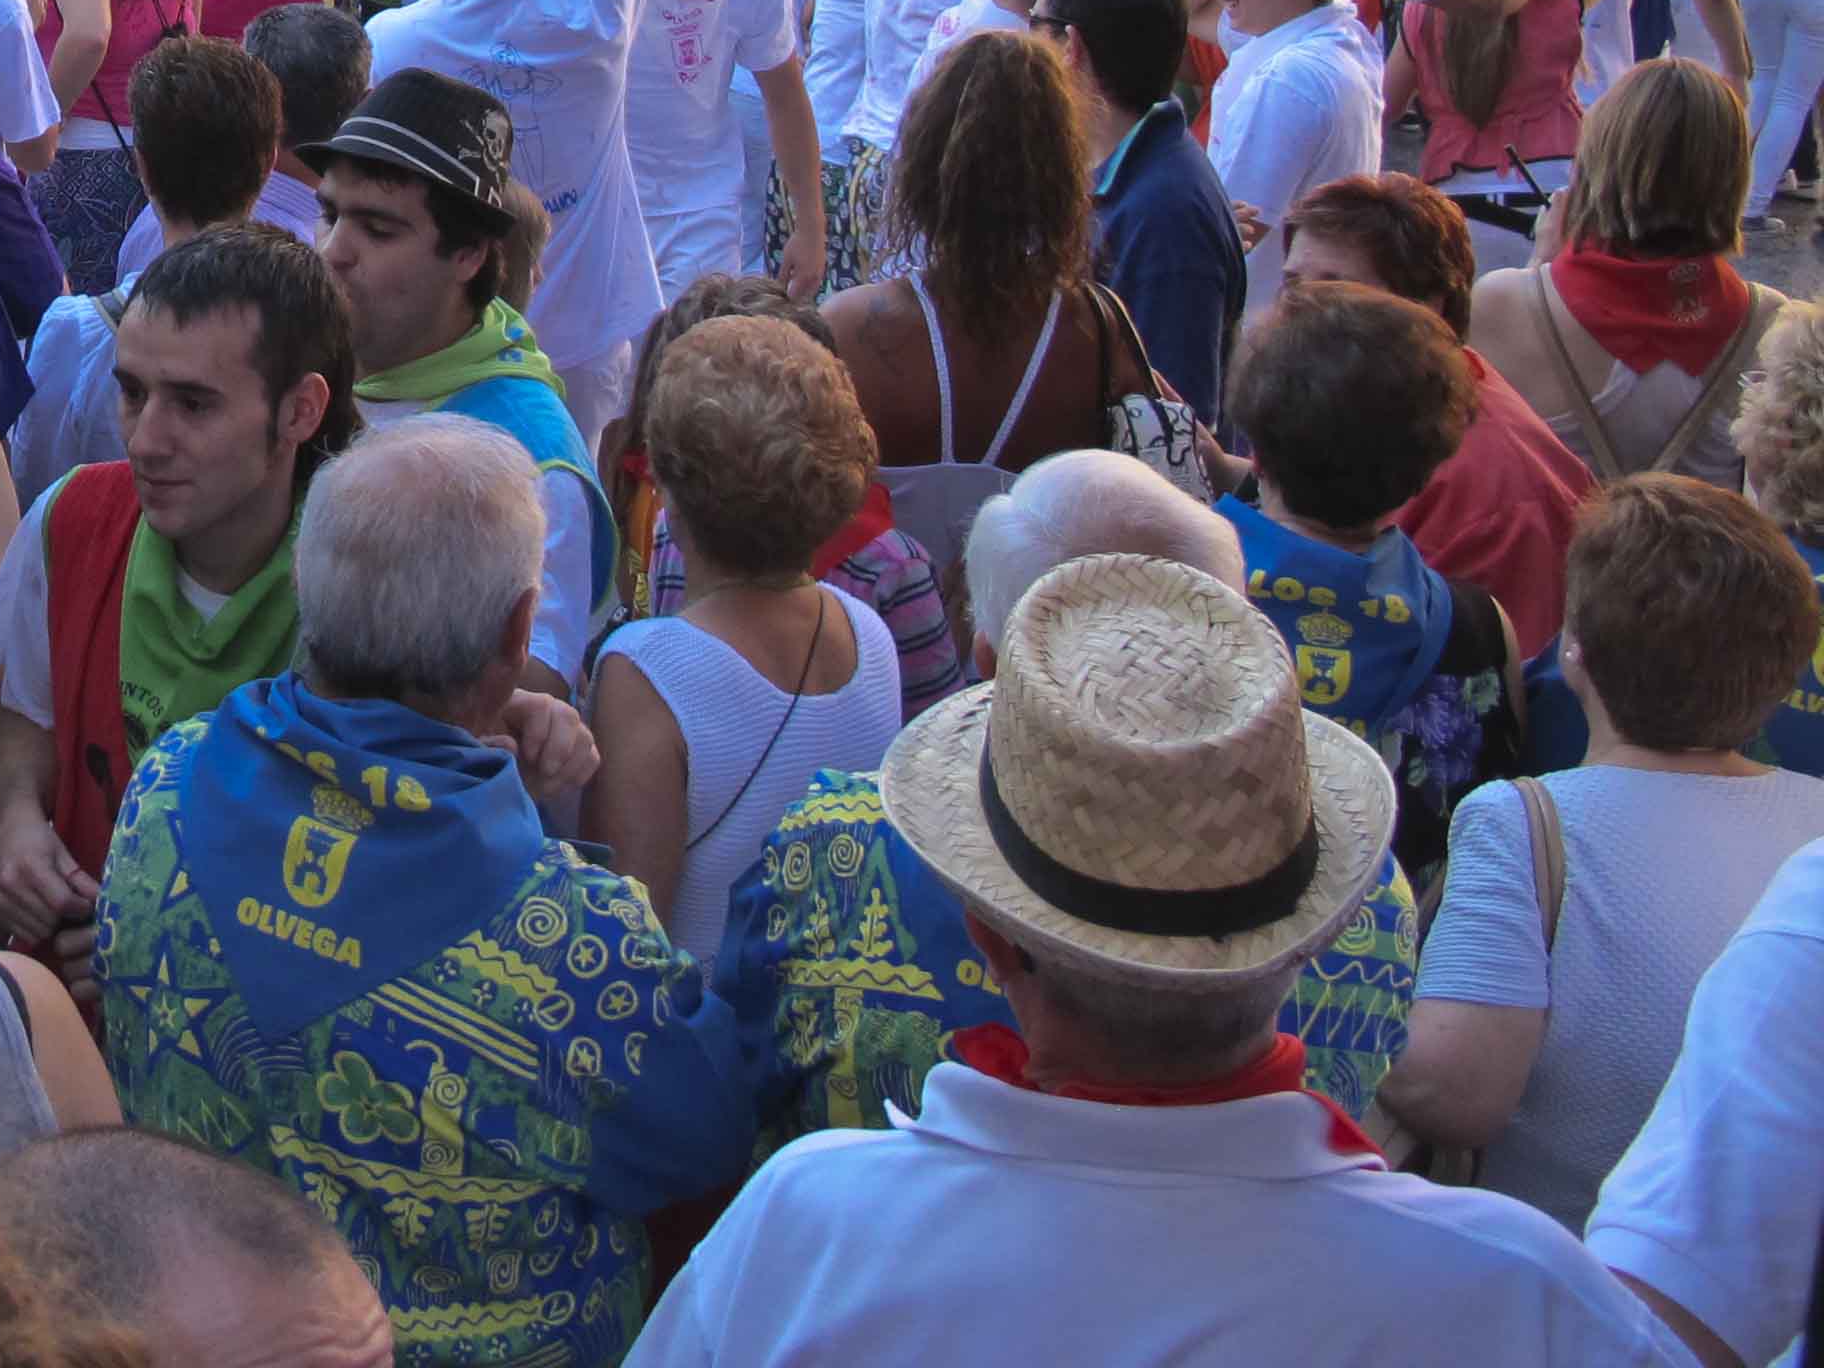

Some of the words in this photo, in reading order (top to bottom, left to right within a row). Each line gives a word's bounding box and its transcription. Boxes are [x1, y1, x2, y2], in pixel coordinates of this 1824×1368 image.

[1247, 568, 1338, 606] LOS
[1357, 593, 1412, 624] 18
[360, 764, 433, 812] 18
[236, 896, 362, 969] OLVEGA
